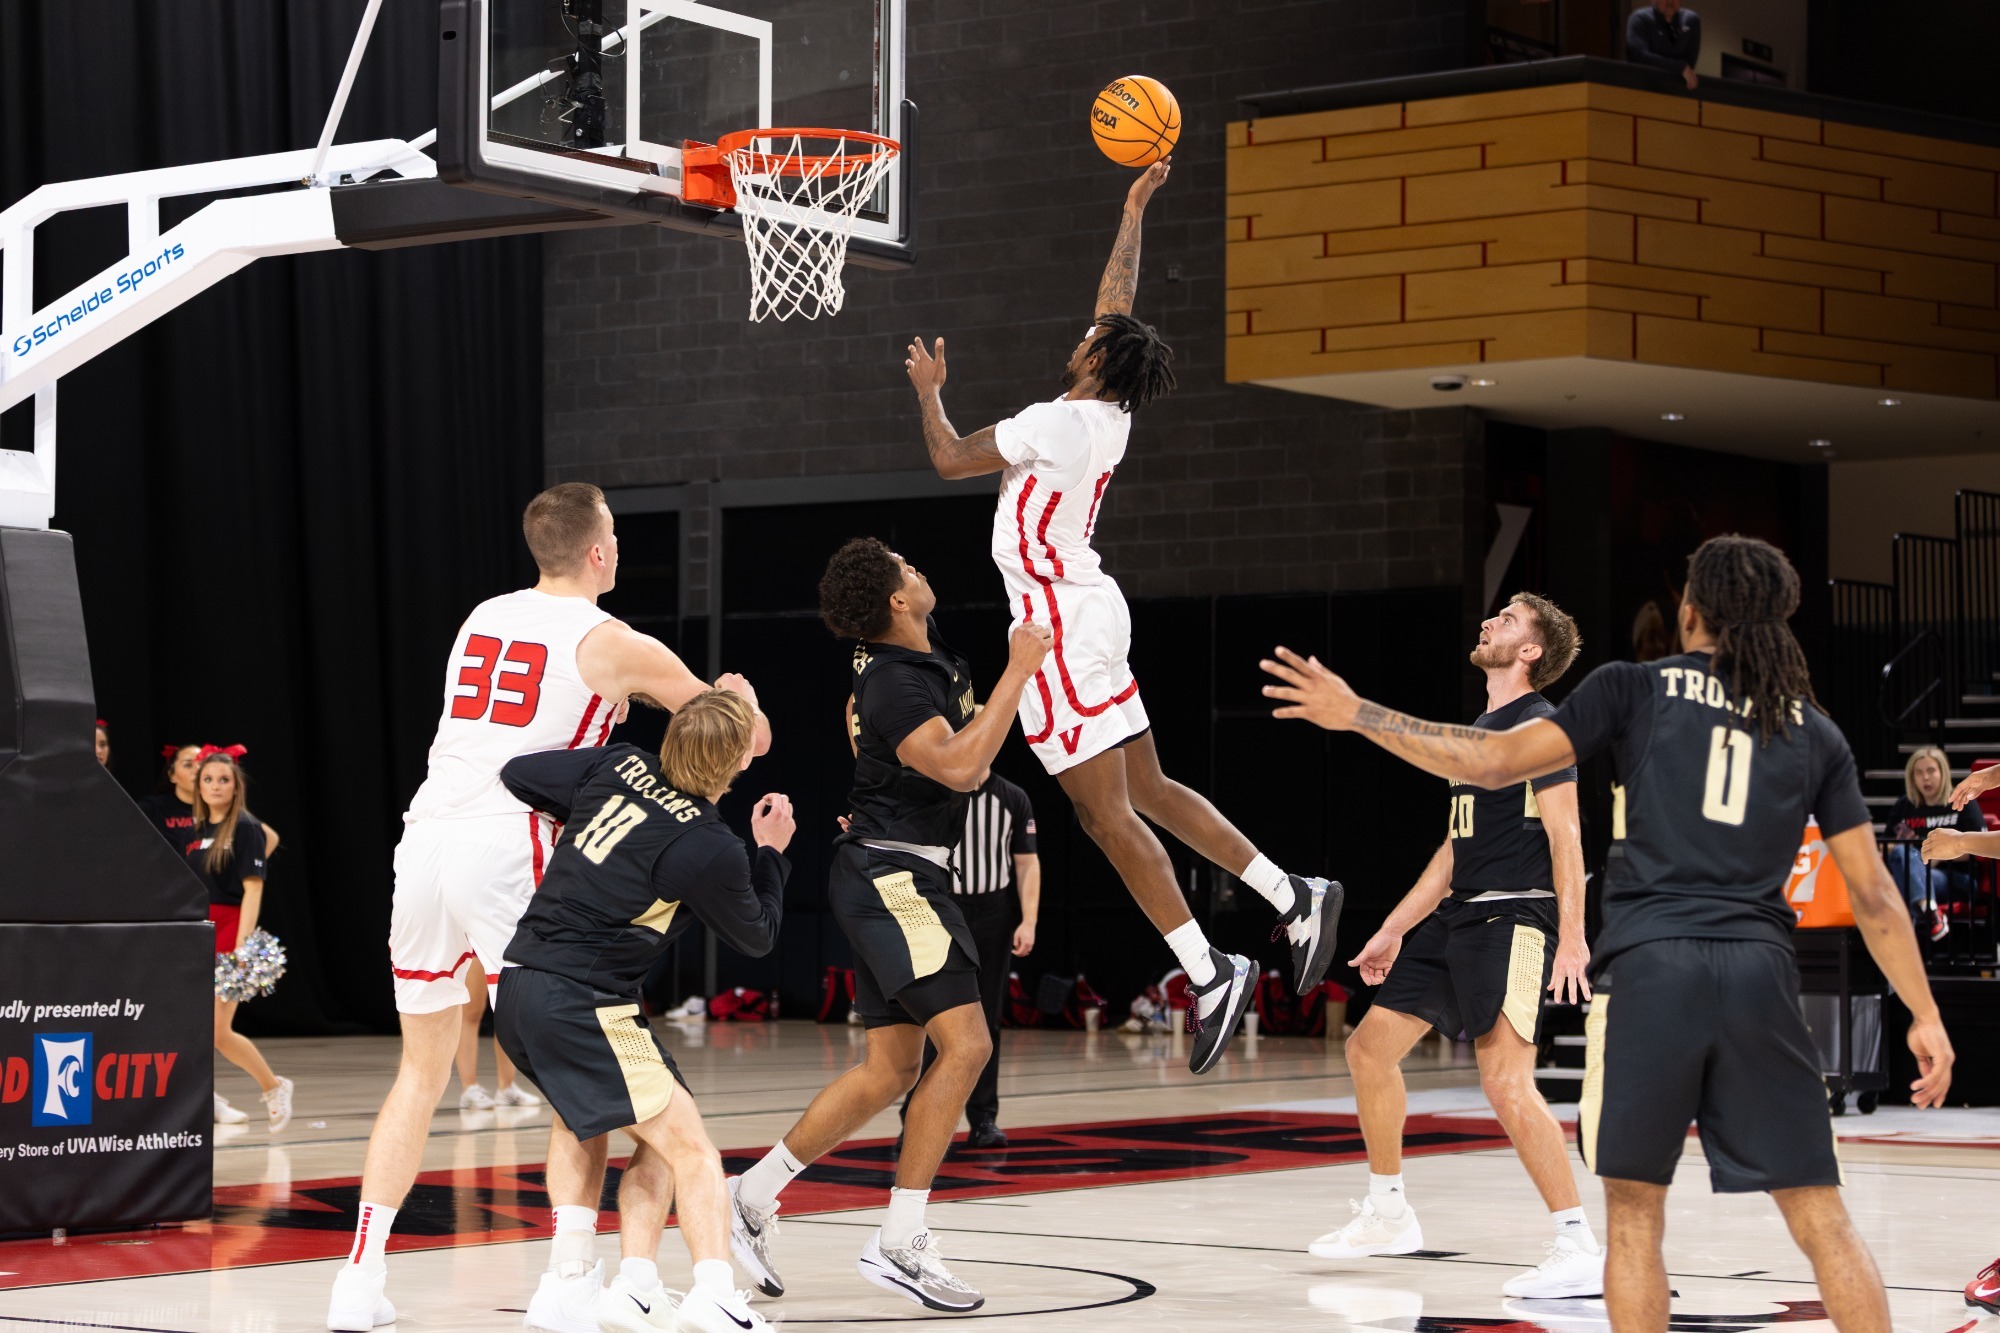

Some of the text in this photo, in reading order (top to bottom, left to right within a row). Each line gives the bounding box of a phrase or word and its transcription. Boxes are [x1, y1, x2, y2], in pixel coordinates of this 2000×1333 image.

[1092, 105, 1118, 129] NCAA
[32, 243, 185, 346] Schelde Sports
[451, 633, 548, 728] 33
[614, 755, 701, 824] TROJANS
[573, 795, 648, 865] 10
[34, 999, 120, 1022] presented
[124, 998, 145, 1021] by
[0, 1052, 178, 1104] D CITY
[18, 1143, 49, 1157] Store
[52, 1141, 65, 1155] of
[67, 1137, 97, 1154] UVA
[98, 1134, 133, 1153] Wise
[136, 1131, 203, 1151] Athletics
